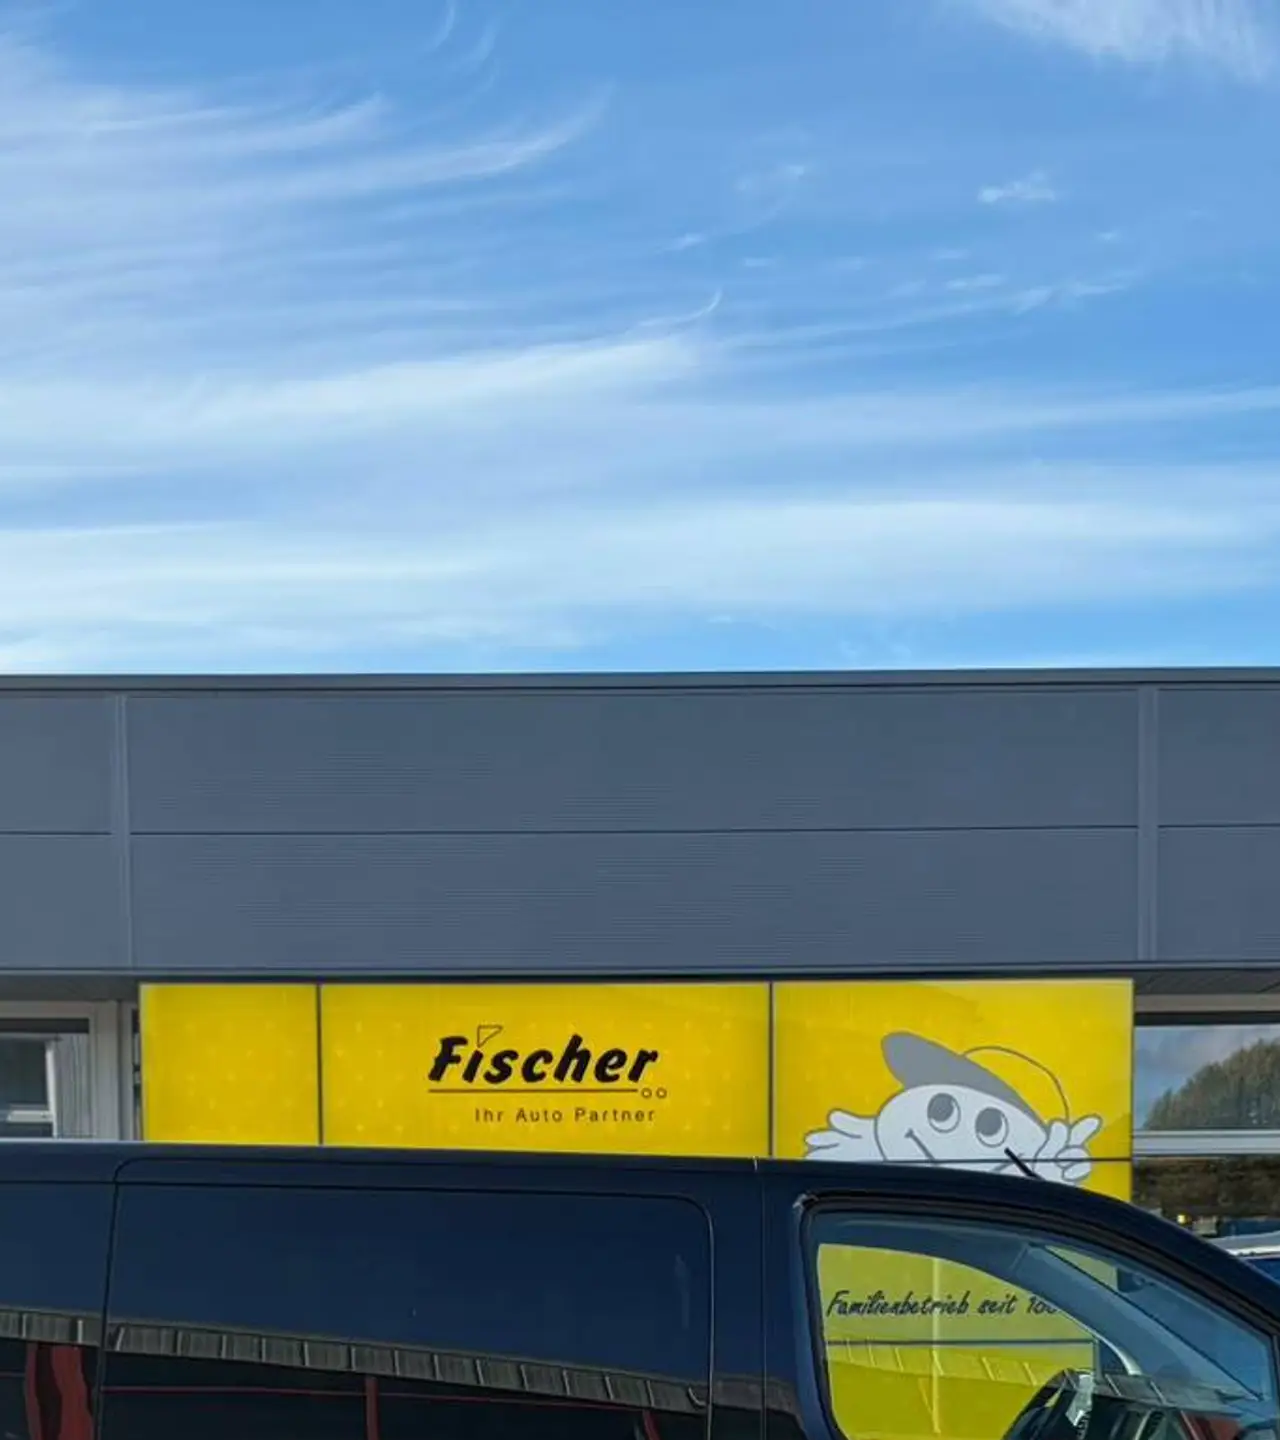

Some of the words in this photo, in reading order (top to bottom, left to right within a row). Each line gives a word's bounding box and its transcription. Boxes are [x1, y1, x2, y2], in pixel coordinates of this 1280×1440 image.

[427, 1033, 659, 1084] Fischer
[475, 1108, 504, 1123] Ihr
[515, 1107, 563, 1123] Auto
[574, 1107, 656, 1123] Partner
[826, 1289, 970, 1317] Familienbetrieb
[977, 1293, 1017, 1315] seit
